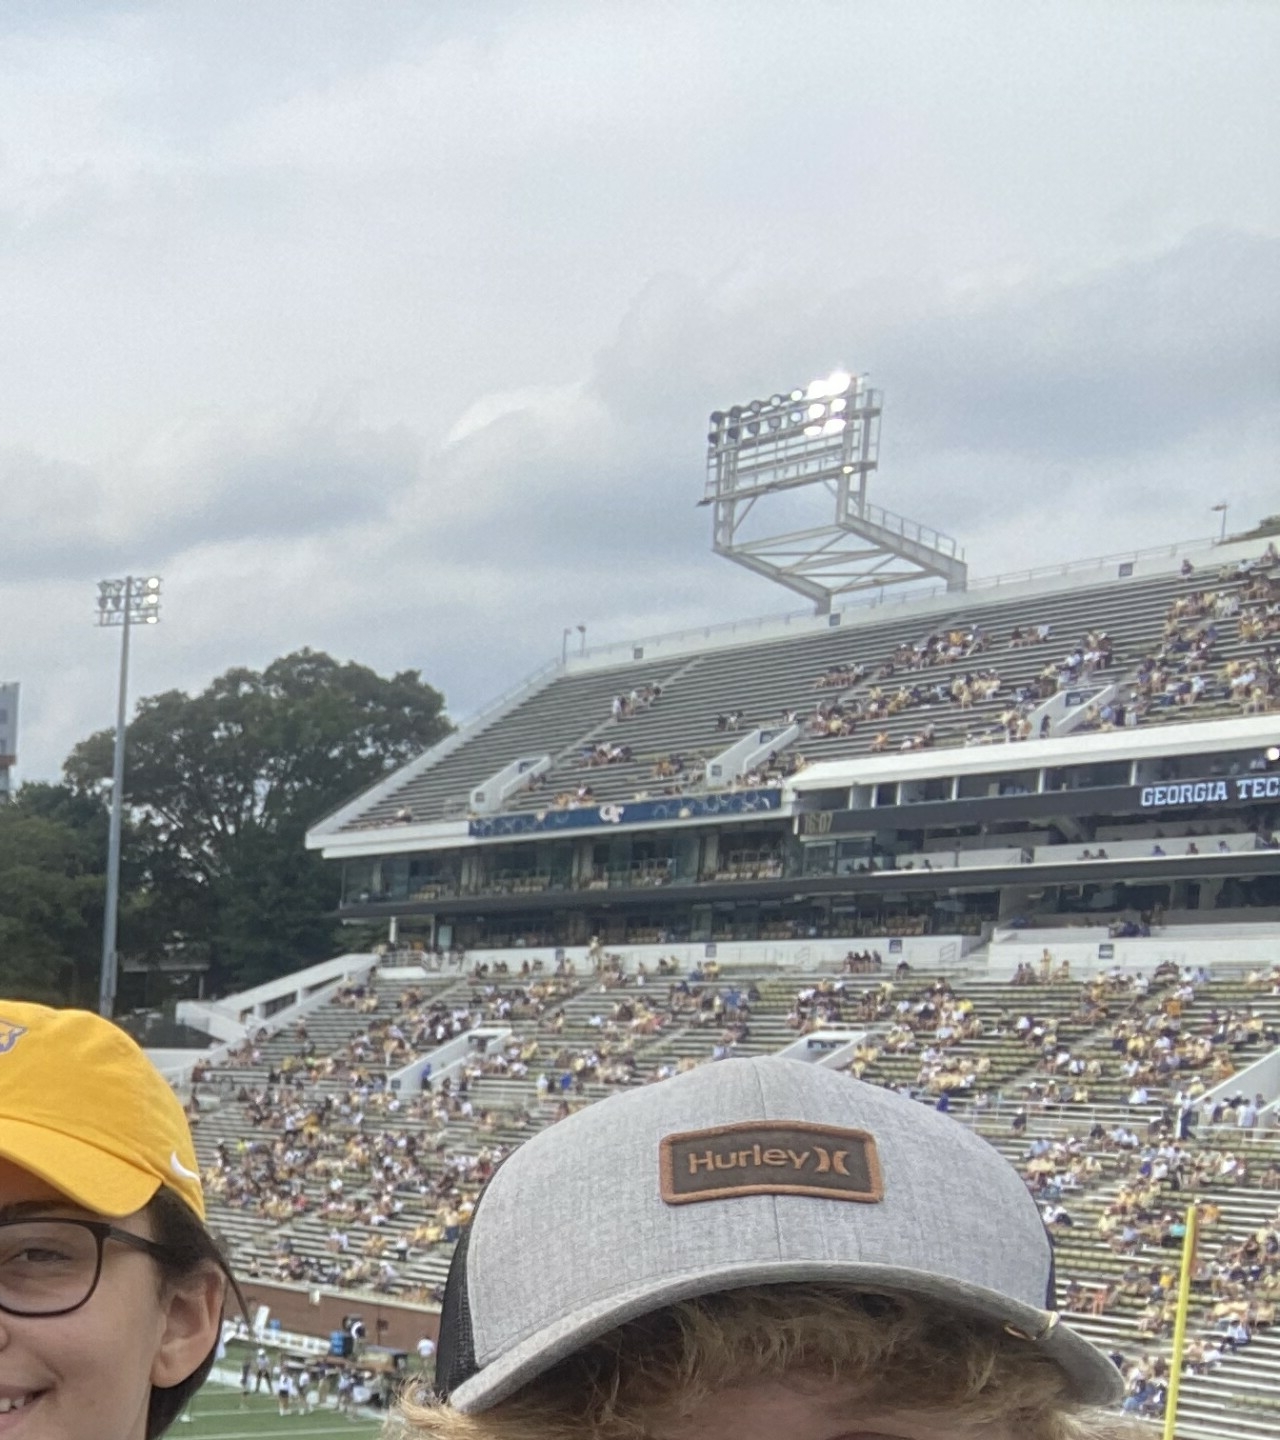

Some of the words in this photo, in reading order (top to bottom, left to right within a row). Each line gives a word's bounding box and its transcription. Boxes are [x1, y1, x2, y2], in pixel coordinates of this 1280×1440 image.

[1141, 782, 1229, 807] GEORGIA
[1236, 777, 1280, 799] TEC
[689, 1144, 811, 1175] Hurley
